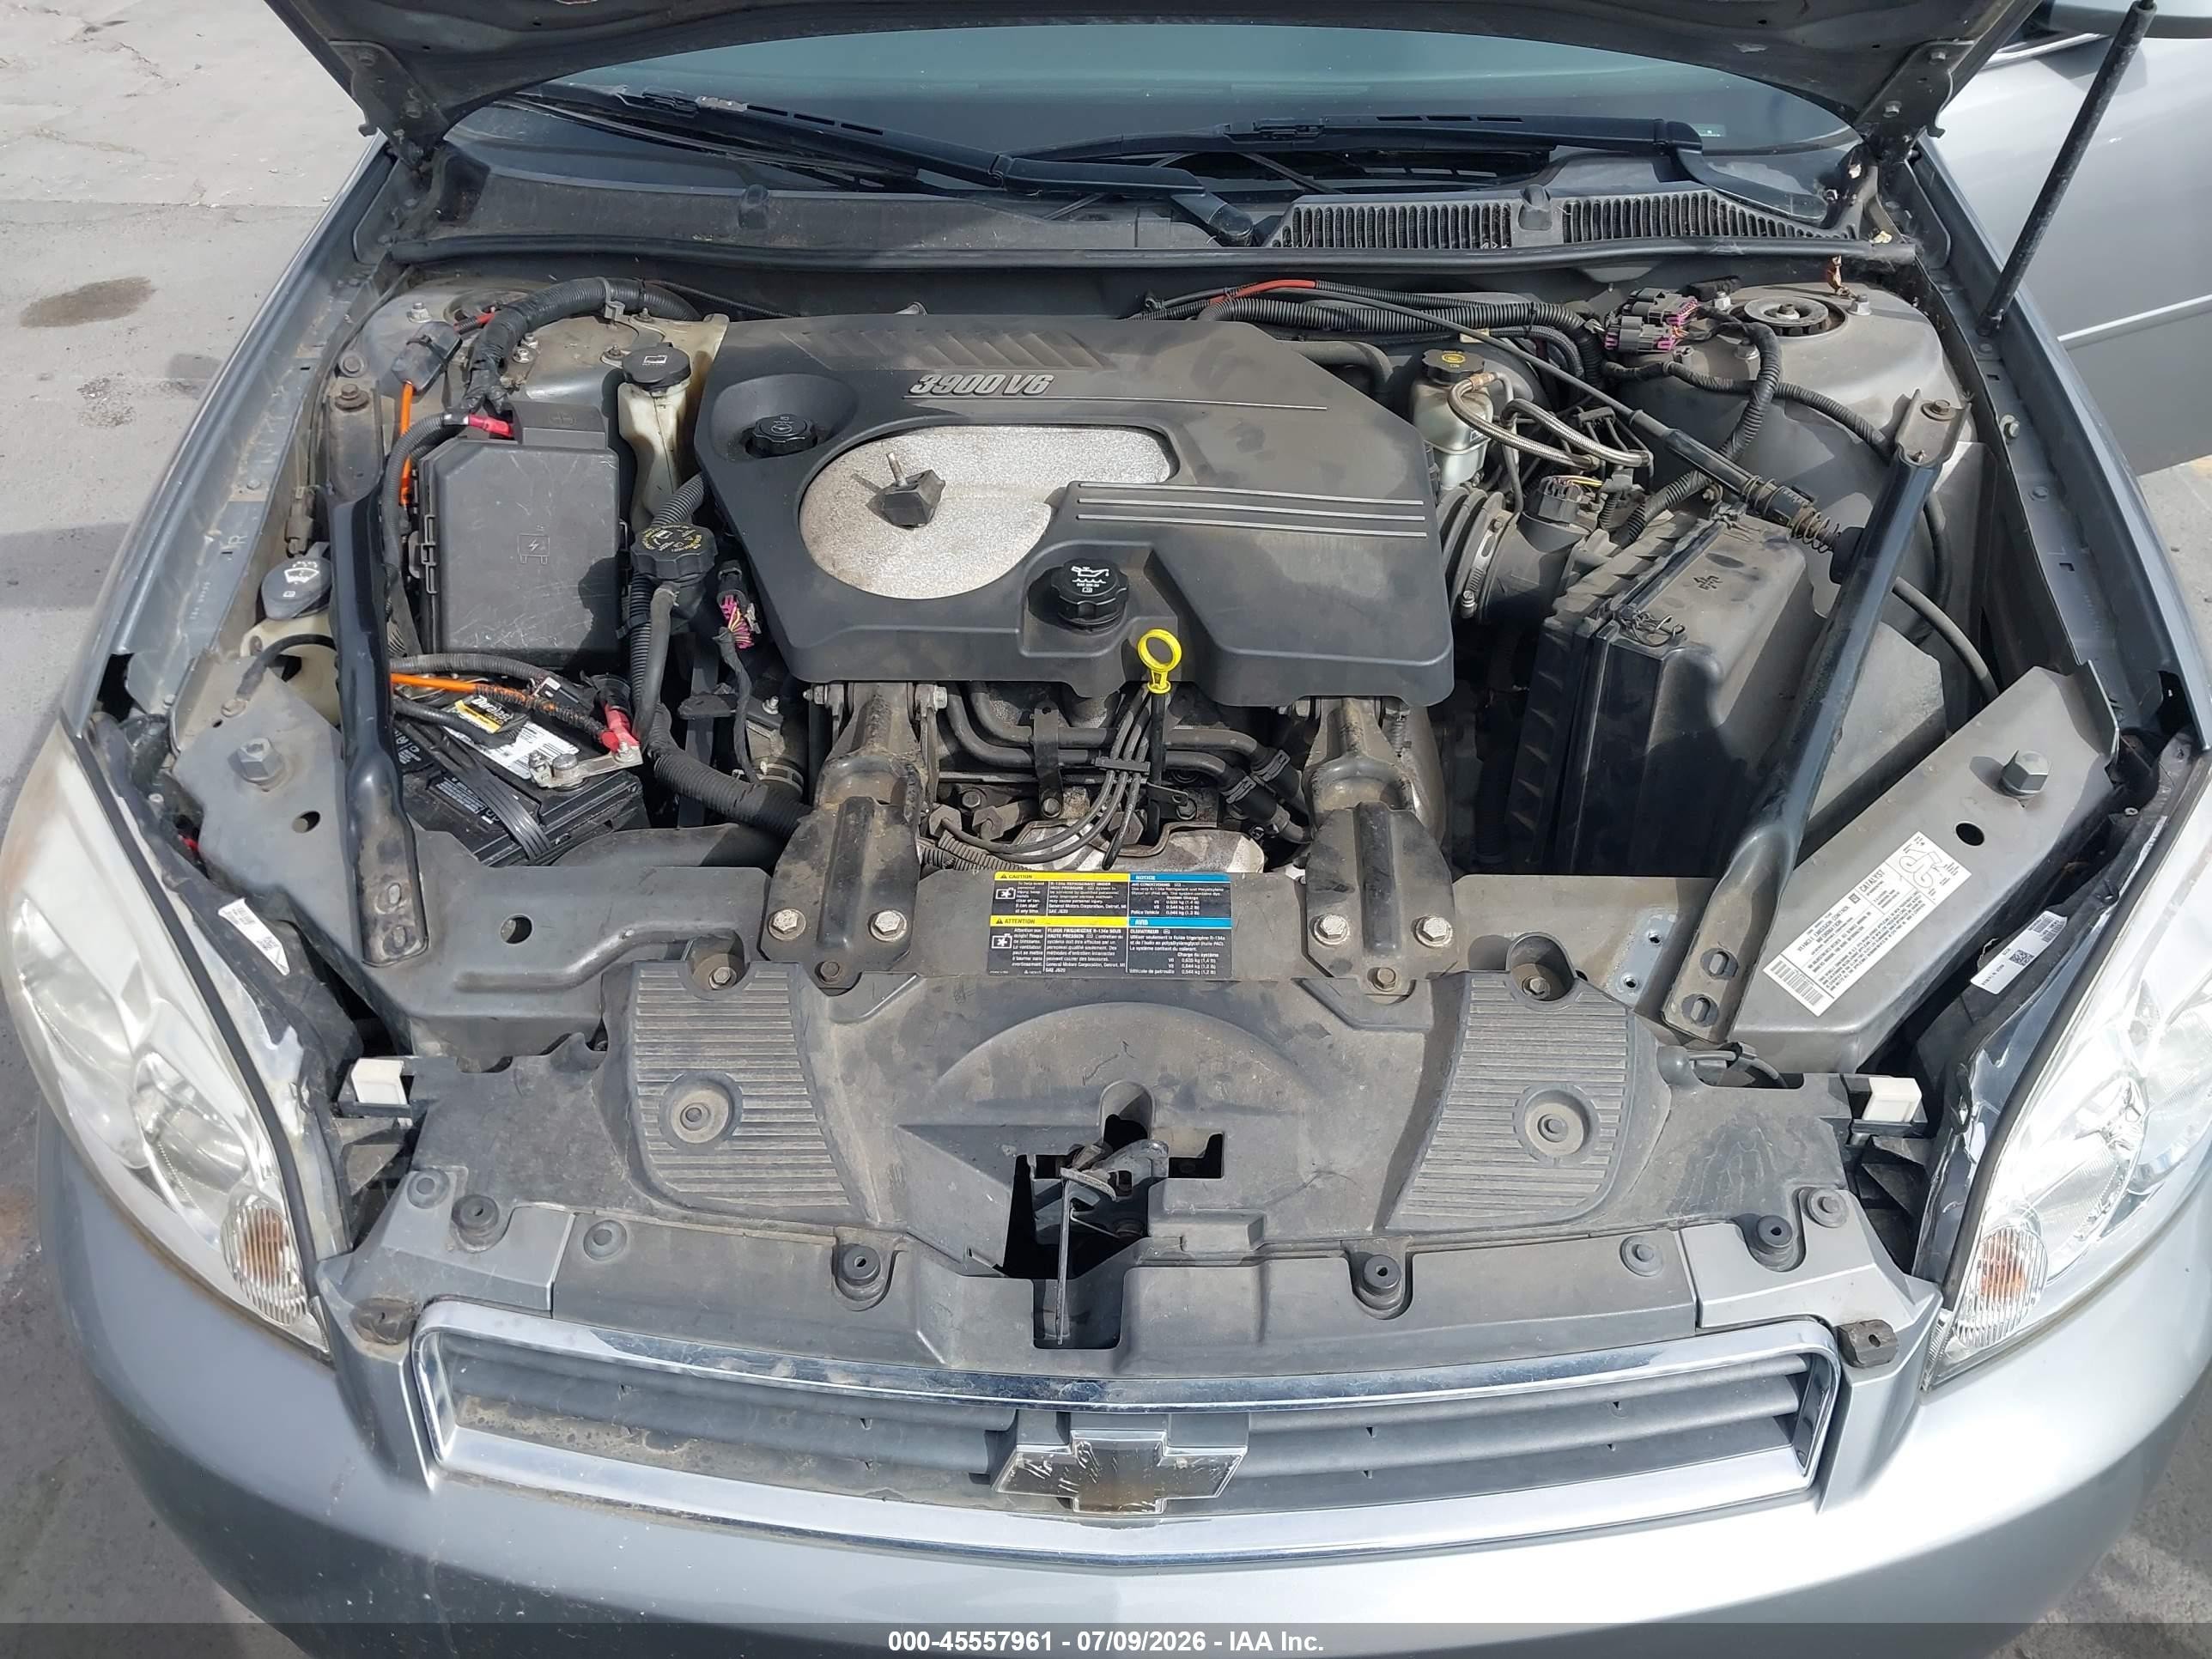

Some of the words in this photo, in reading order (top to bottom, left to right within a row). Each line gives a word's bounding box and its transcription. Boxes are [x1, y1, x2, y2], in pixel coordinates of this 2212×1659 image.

[909, 374, 1006, 395] 3900
[1003, 374, 1054, 395] V6
[471, 695, 514, 722] Duralast
[1858, 868, 1885, 892] CATALYST
